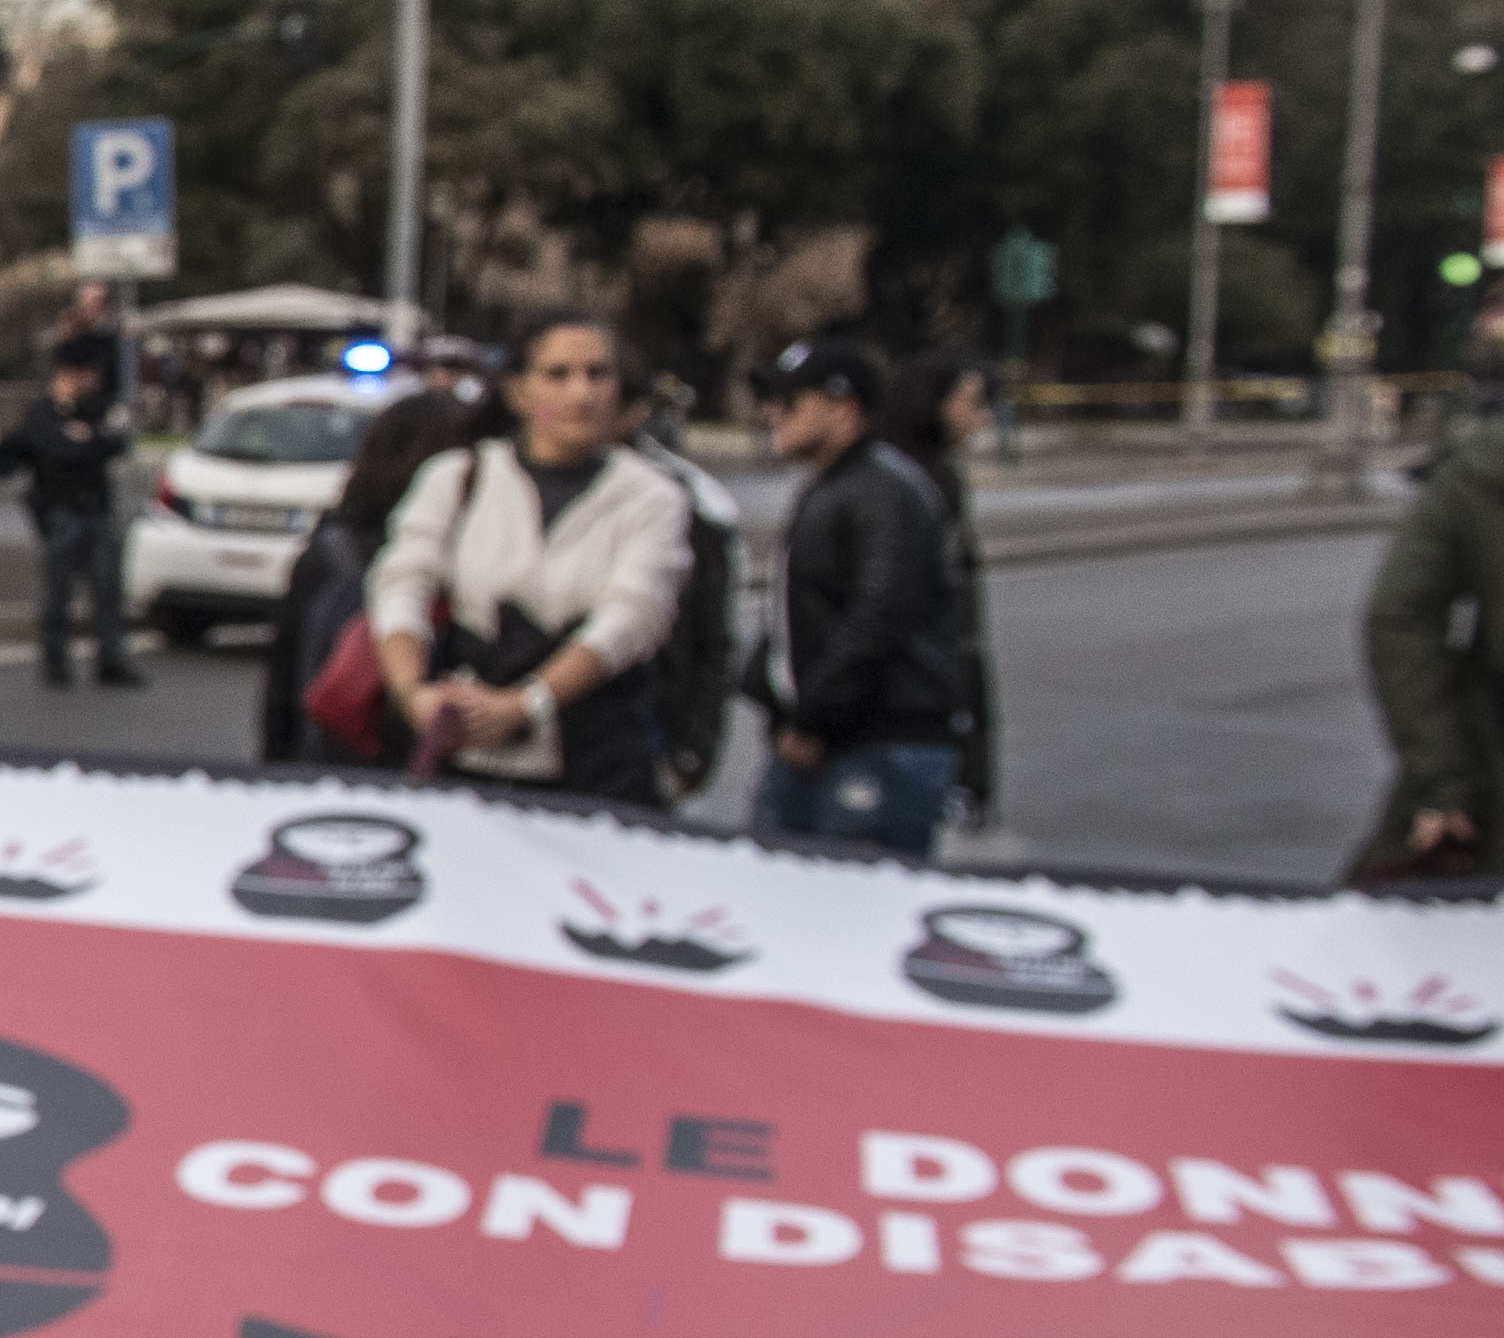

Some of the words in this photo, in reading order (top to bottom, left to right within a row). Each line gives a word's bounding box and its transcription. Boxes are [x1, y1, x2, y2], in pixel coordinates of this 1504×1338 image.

[93, 129, 155, 215] P
[174, 1137, 634, 1250] CON
[534, 1098, 779, 1182] LE
[858, 1128, 1504, 1237] DONN
